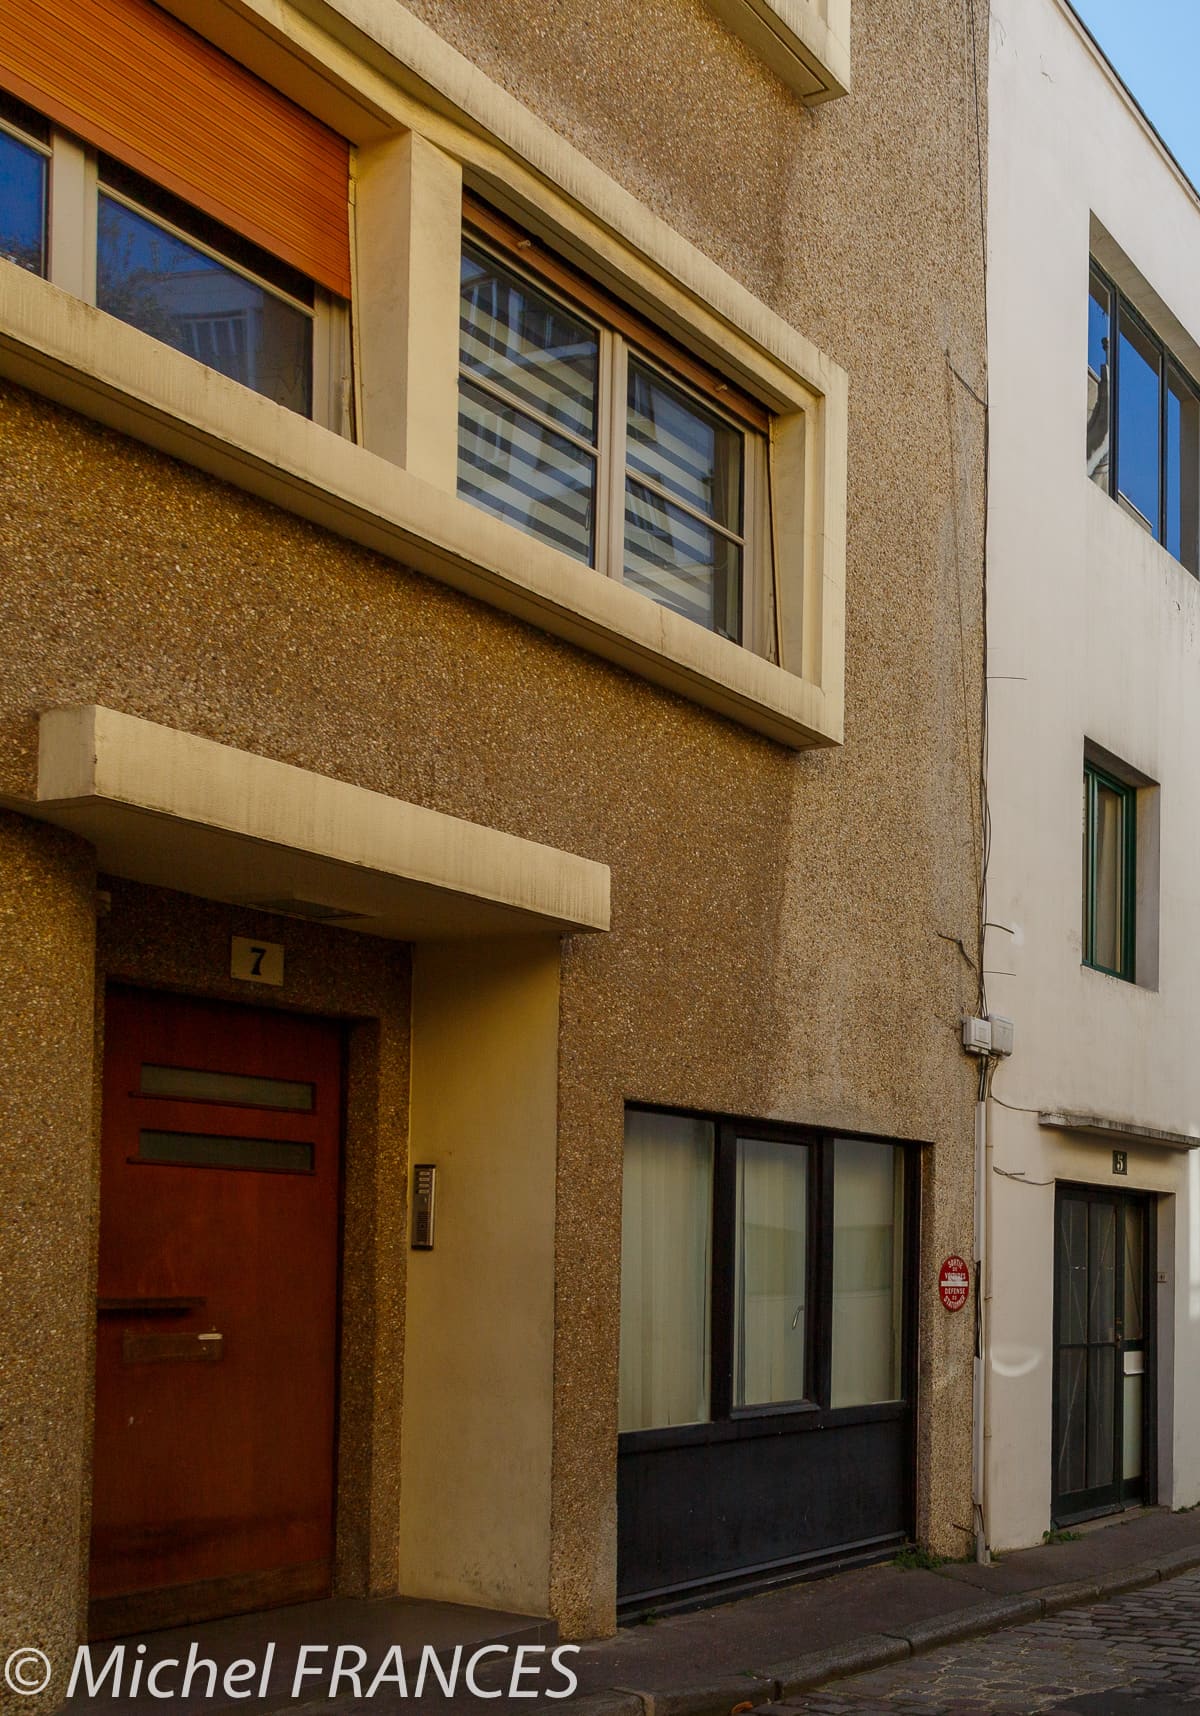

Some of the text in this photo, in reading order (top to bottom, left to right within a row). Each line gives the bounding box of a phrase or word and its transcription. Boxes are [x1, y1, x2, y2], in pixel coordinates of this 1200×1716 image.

[251, 947, 267, 976] 7
[1116, 1154, 1124, 1171] 5
[944, 1287, 966, 1295] DEFENSE
